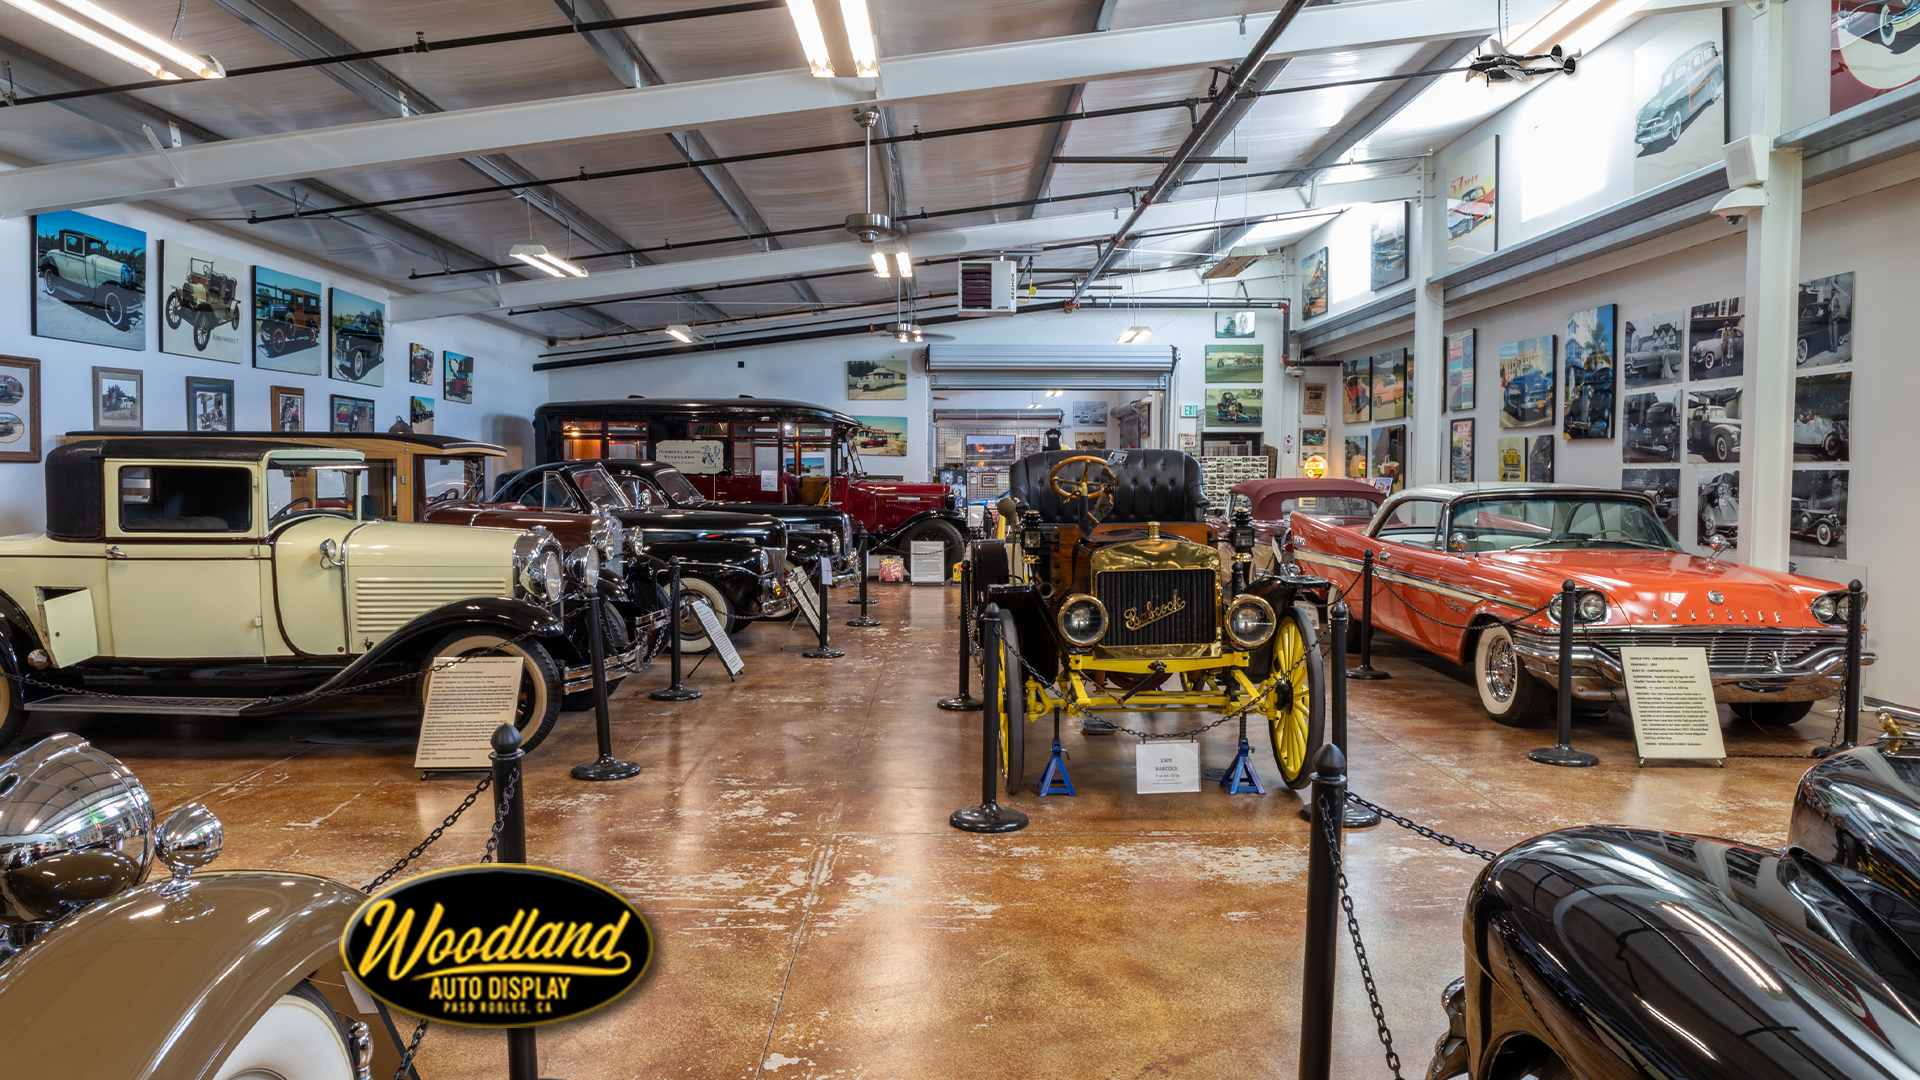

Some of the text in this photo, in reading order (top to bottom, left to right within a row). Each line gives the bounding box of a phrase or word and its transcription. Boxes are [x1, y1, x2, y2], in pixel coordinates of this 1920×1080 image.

[1449, 340, 1463, 349] MOTOR
[1449, 348, 1463, 359] TREND
[1184, 405, 1199, 416] EXIT
[1124, 588, 1186, 630] Babcock
[1652, 608, 1782, 623] CHRYSLER
